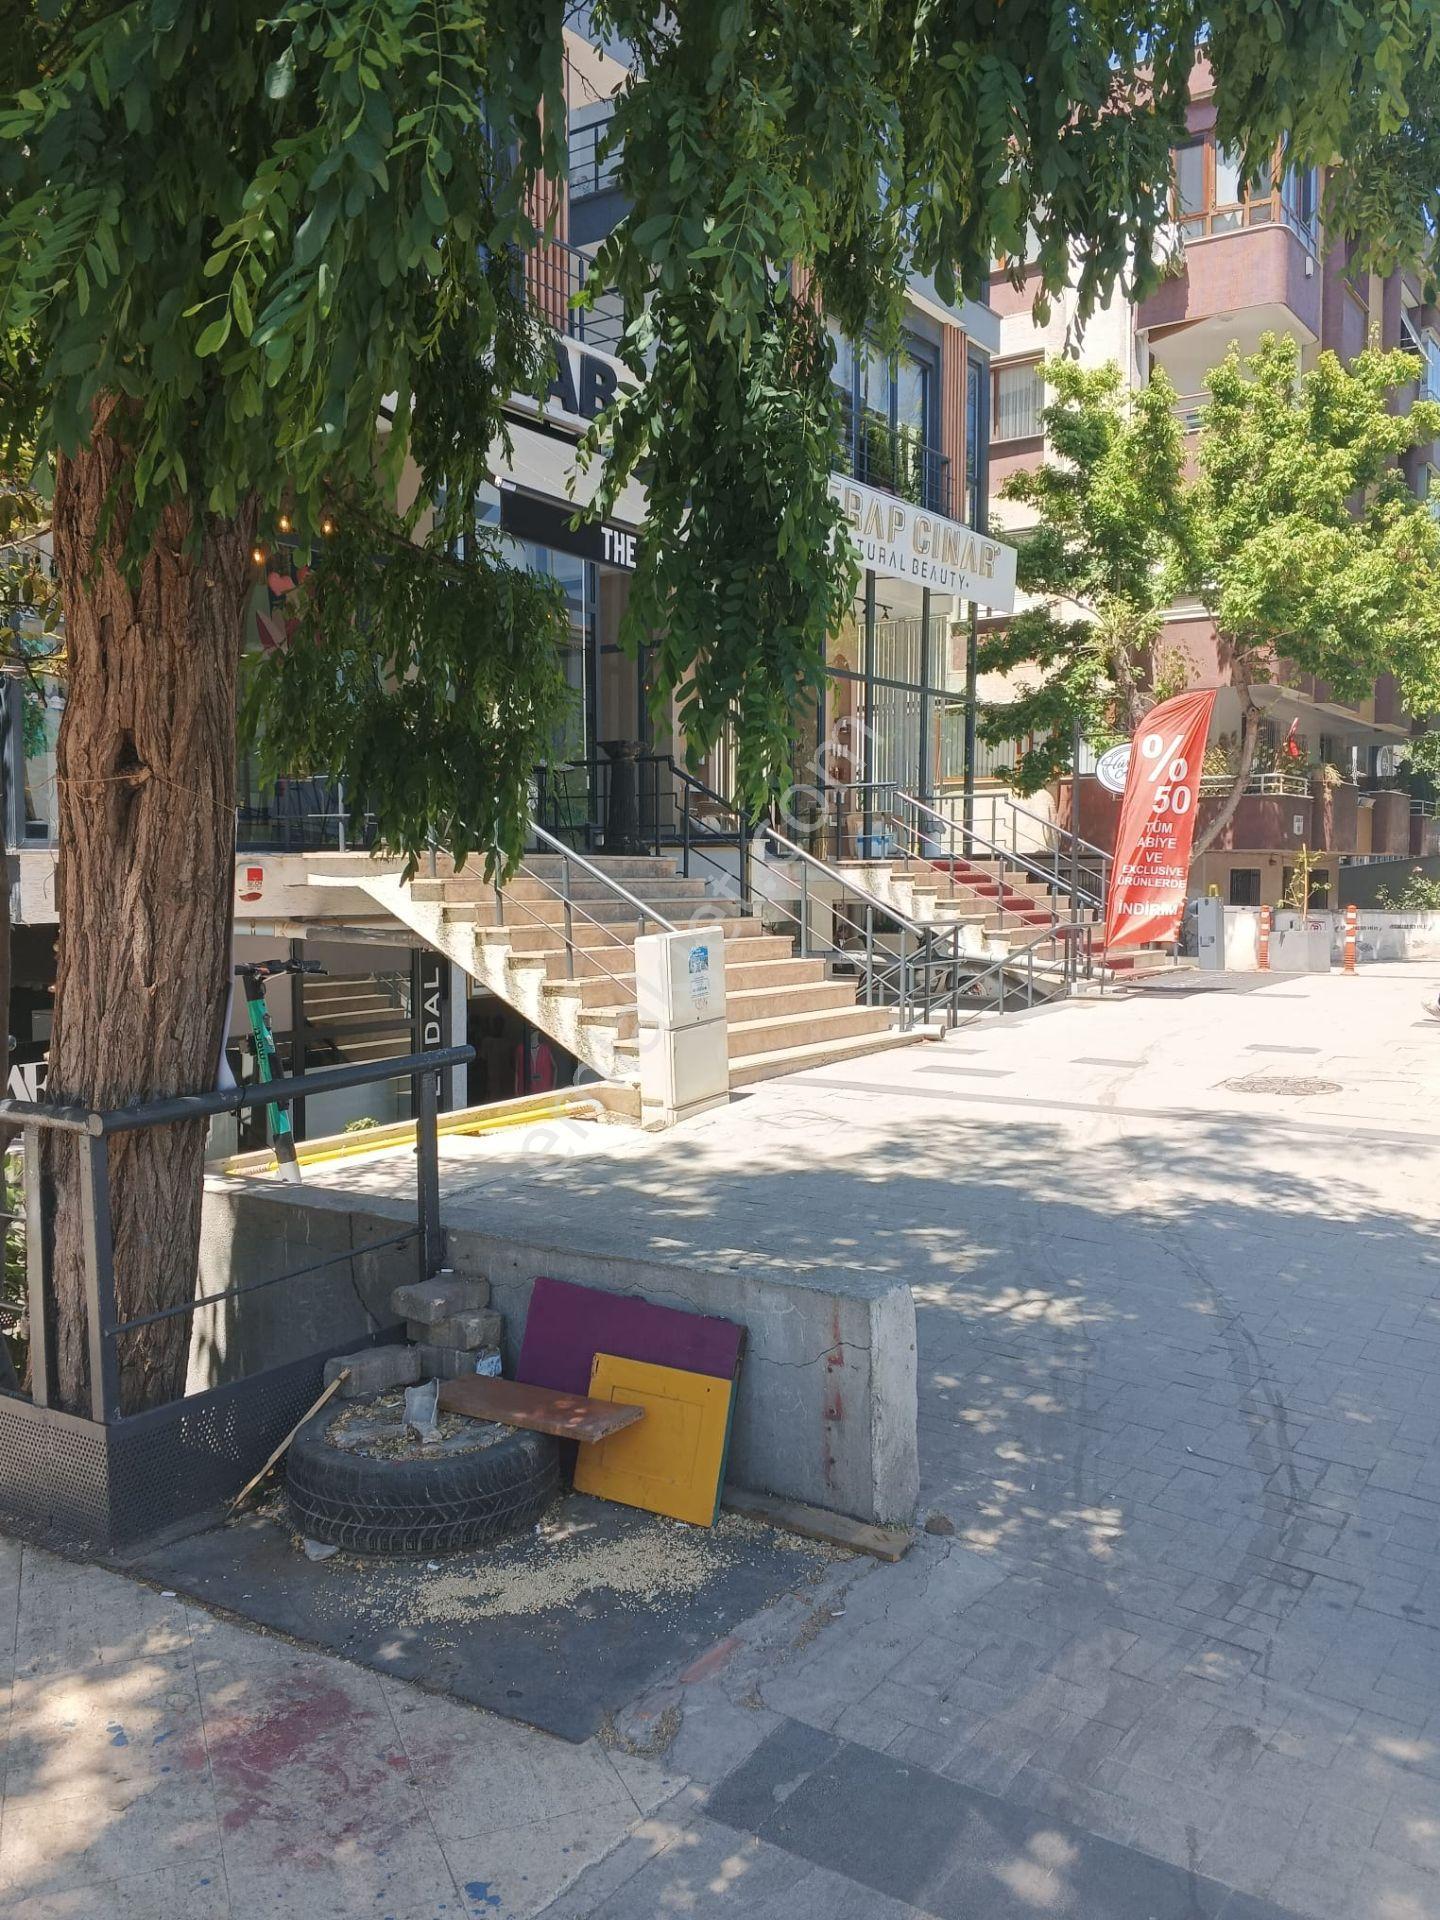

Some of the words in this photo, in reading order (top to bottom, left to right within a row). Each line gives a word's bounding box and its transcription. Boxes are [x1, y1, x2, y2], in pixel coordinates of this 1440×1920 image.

[829, 481, 906, 545] RAP
[601, 526, 637, 569] THE
[1142, 733, 1188, 783] %
[1151, 785, 1191, 814] 50
[1146, 820, 1173, 834] TÜM
[1137, 835, 1177, 849] ABİYE
[1145, 851, 1163, 863] VE
[1117, 874, 1187, 889] ÜRÜNLERDE
[424, 967, 441, 1096] DAL
